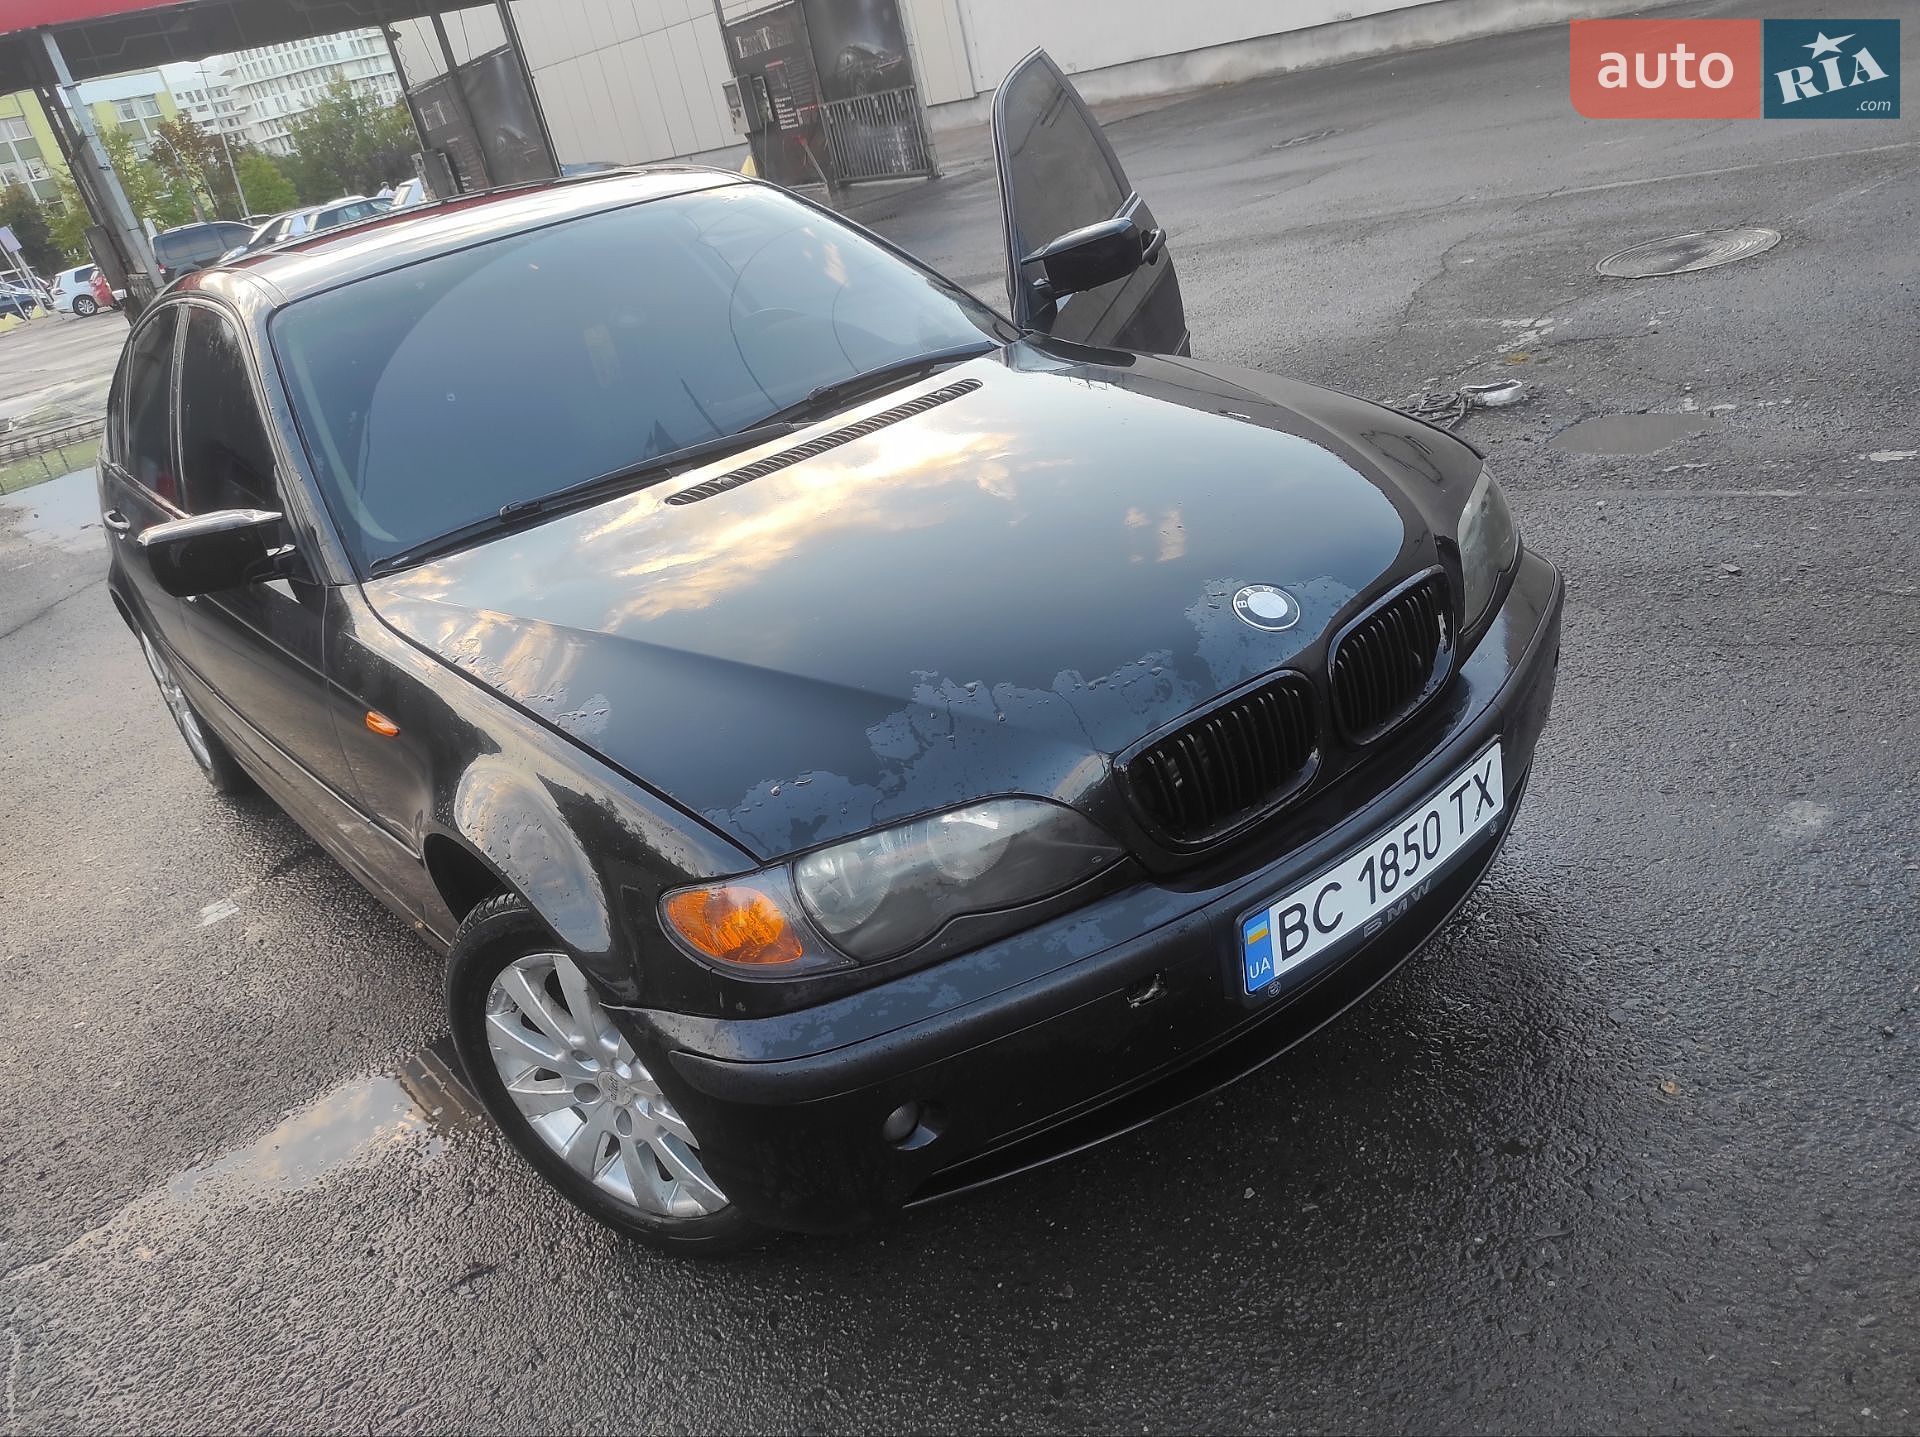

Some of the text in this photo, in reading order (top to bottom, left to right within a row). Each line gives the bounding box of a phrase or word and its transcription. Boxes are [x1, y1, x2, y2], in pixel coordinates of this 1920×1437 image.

[1236, 585, 1274, 608] BMW
[1278, 760, 1495, 962] BC 1850 TX
[1363, 879, 1432, 938] BMW
[1249, 956, 1271, 979] UA
